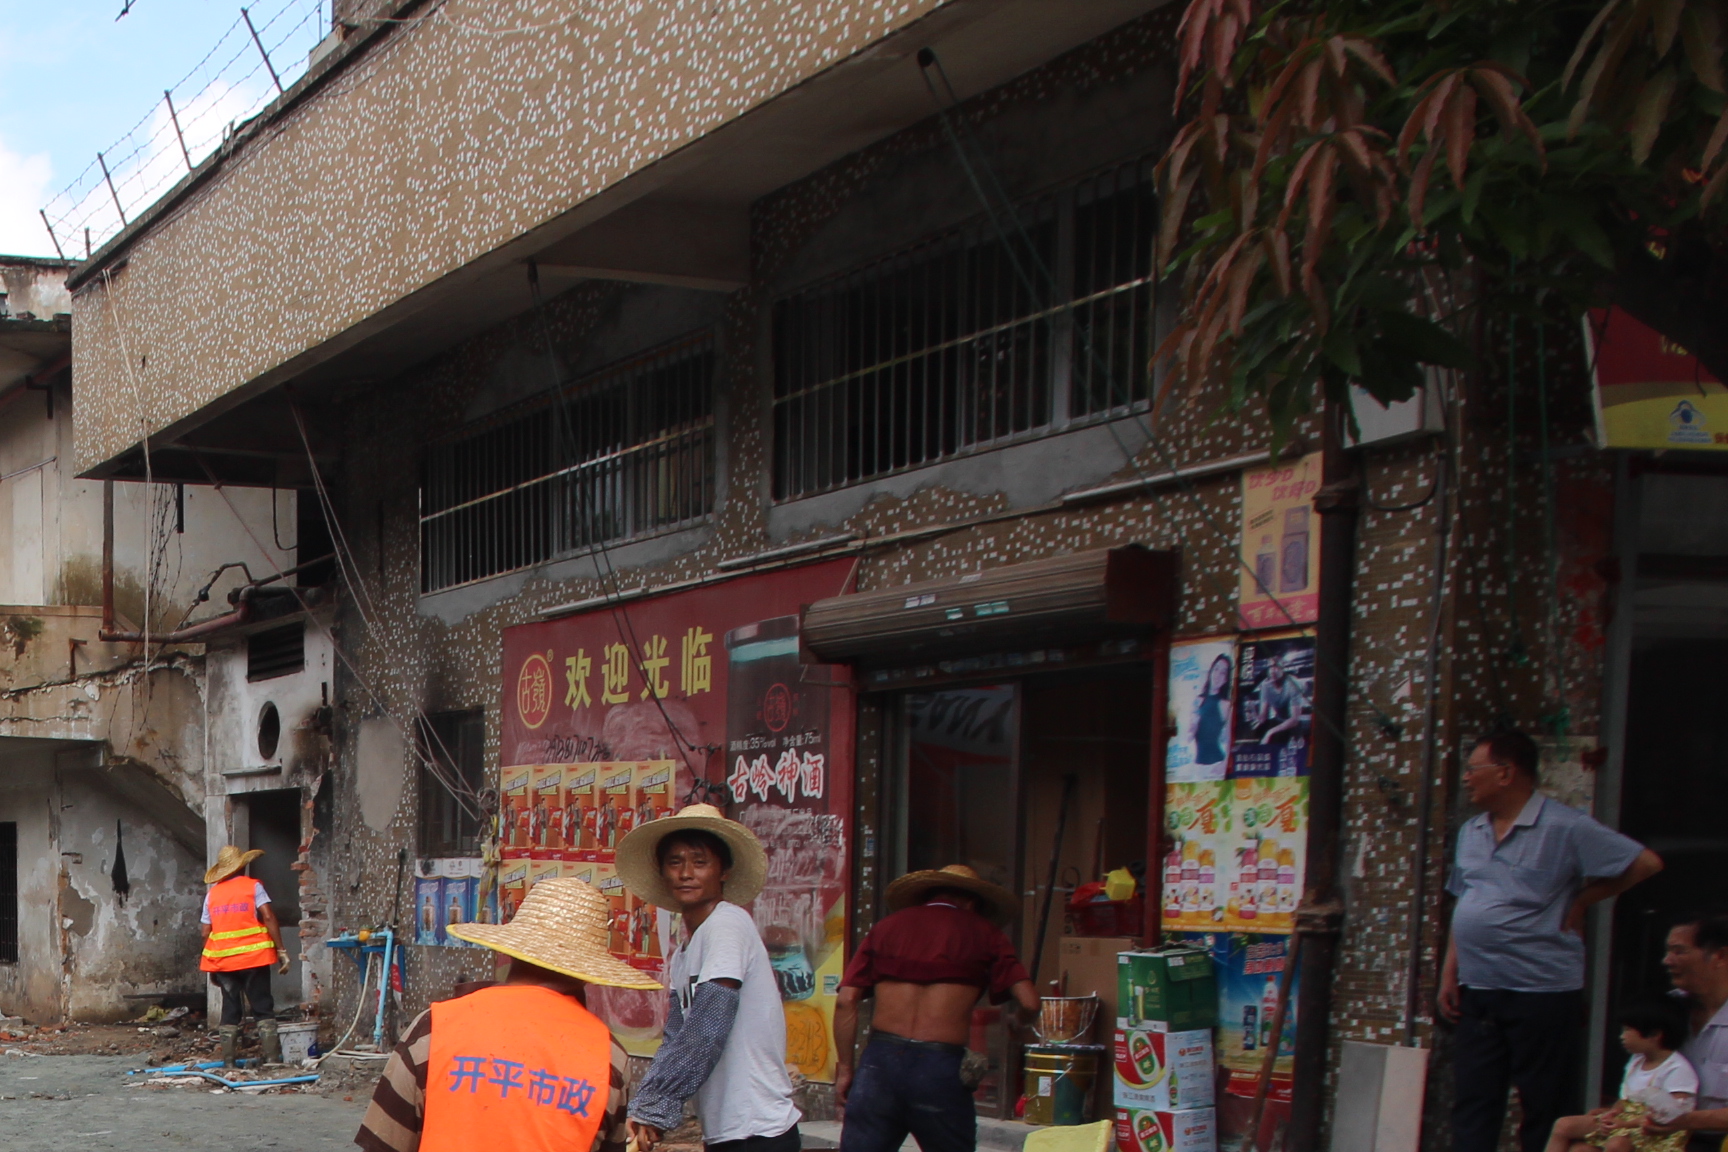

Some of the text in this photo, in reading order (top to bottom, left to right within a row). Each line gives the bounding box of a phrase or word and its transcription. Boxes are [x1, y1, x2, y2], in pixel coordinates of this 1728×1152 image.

[565, 626, 713, 711] 欢迎光临
[727, 748, 825, 803] 古岭神酒
[212, 902, 250, 915] 开平市政
[449, 1055, 596, 1118] 开平市政
